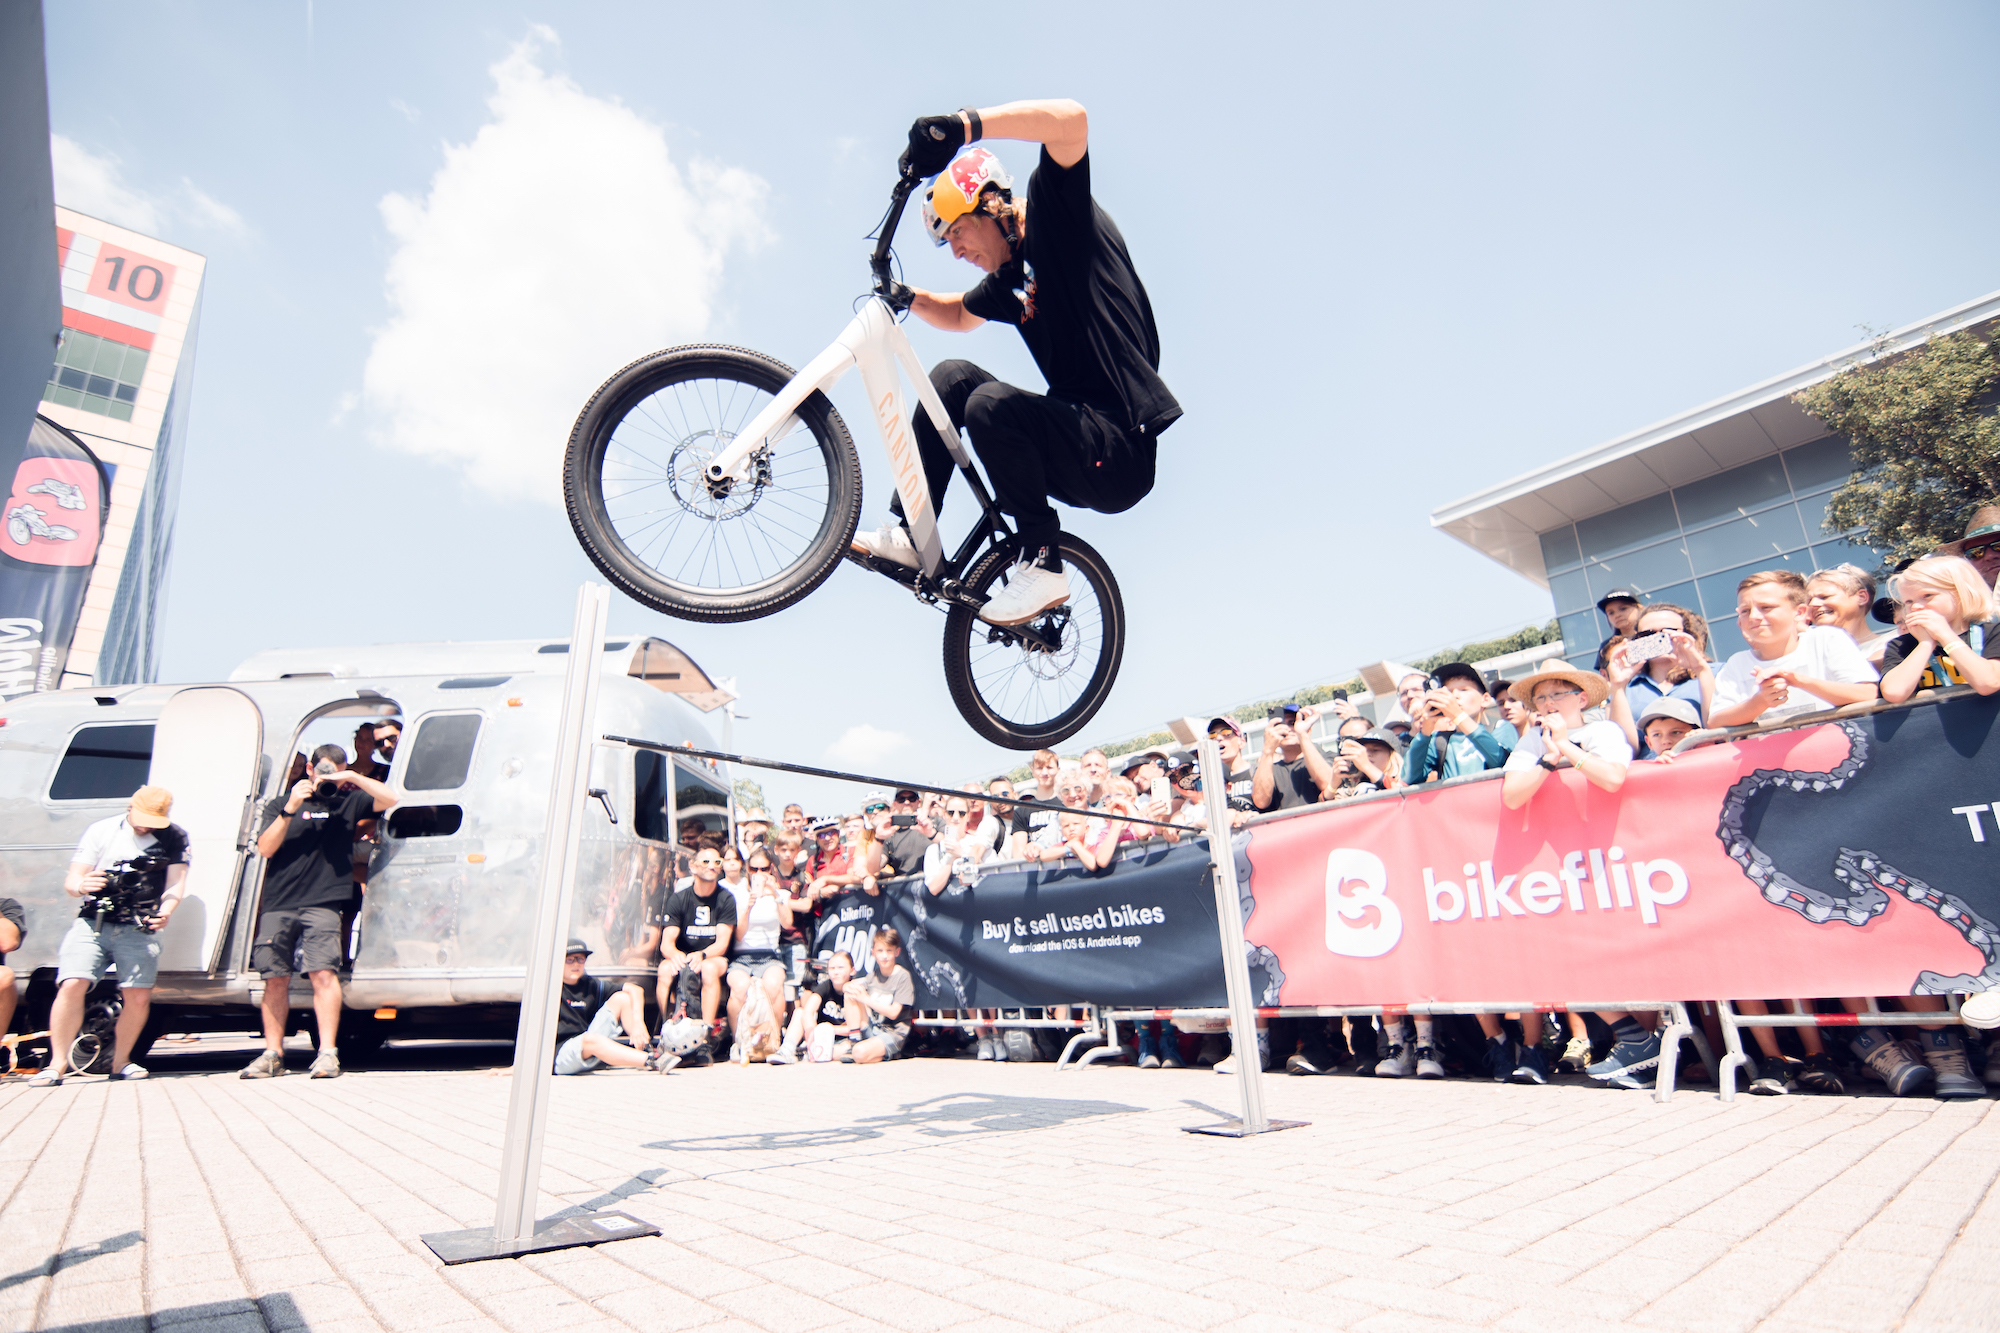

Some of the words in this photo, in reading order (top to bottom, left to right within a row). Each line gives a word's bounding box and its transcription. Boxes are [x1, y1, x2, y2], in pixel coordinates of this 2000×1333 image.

[104, 256, 164, 302] 10
[878, 391, 926, 521] CANYON
[1951, 801, 2000, 843] T
[1421, 845, 1691, 924] bikeflip
[841, 904, 875, 922] bikeflip
[982, 920, 1011, 943] Buy
[1013, 916, 1028, 937] &
[1029, 912, 1059, 936] sell
[1060, 907, 1107, 933] used
[1107, 903, 1166, 929] bikes
[1008, 940, 1048, 954] download
[1048, 939, 1062, 951] the
[1062, 938, 1077, 951] iOS
[1078, 937, 1086, 949] &
[1086, 934, 1121, 949] Android
[1122, 934, 1142, 948] app
